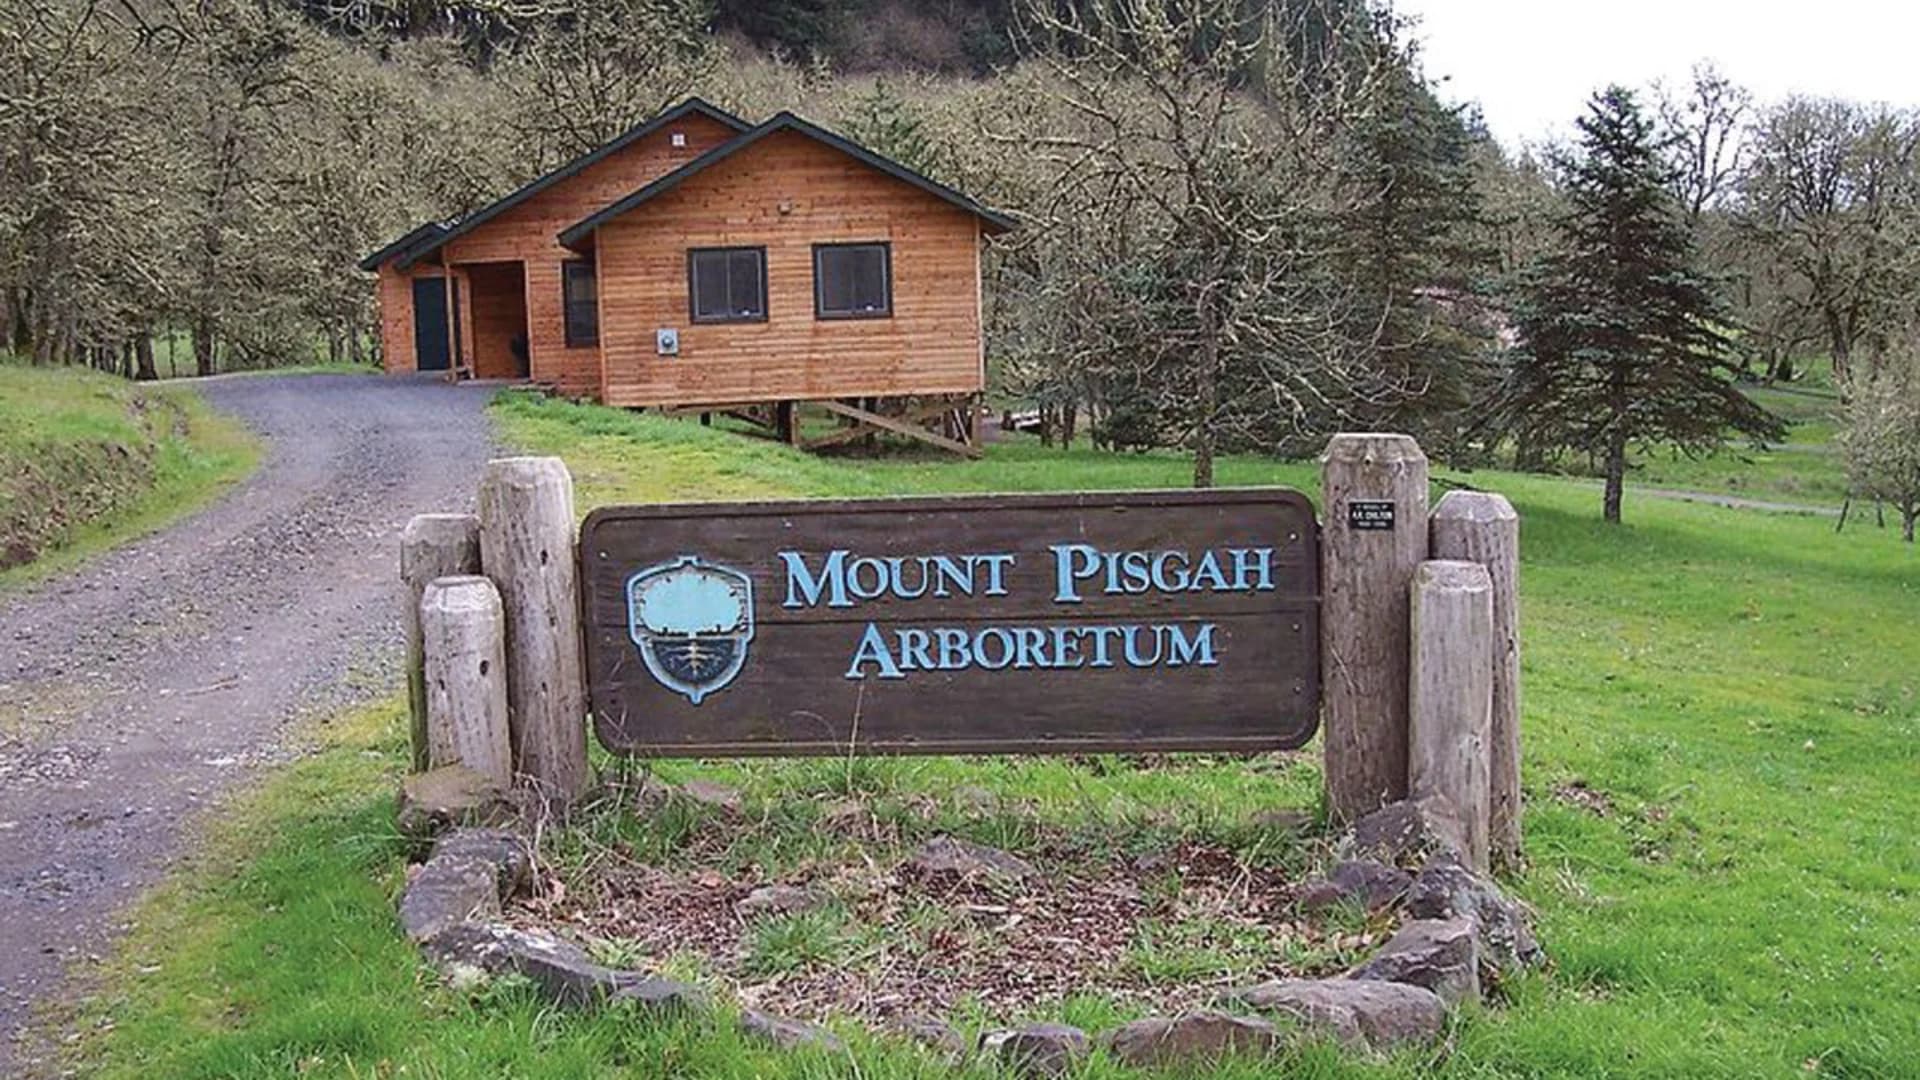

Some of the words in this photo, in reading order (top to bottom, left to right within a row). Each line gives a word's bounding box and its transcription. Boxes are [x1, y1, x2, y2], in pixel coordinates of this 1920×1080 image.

[779, 549, 1016, 608] MOUNT
[1052, 543, 1276, 604] PISGAH
[845, 621, 1217, 679] ARBORETUM
